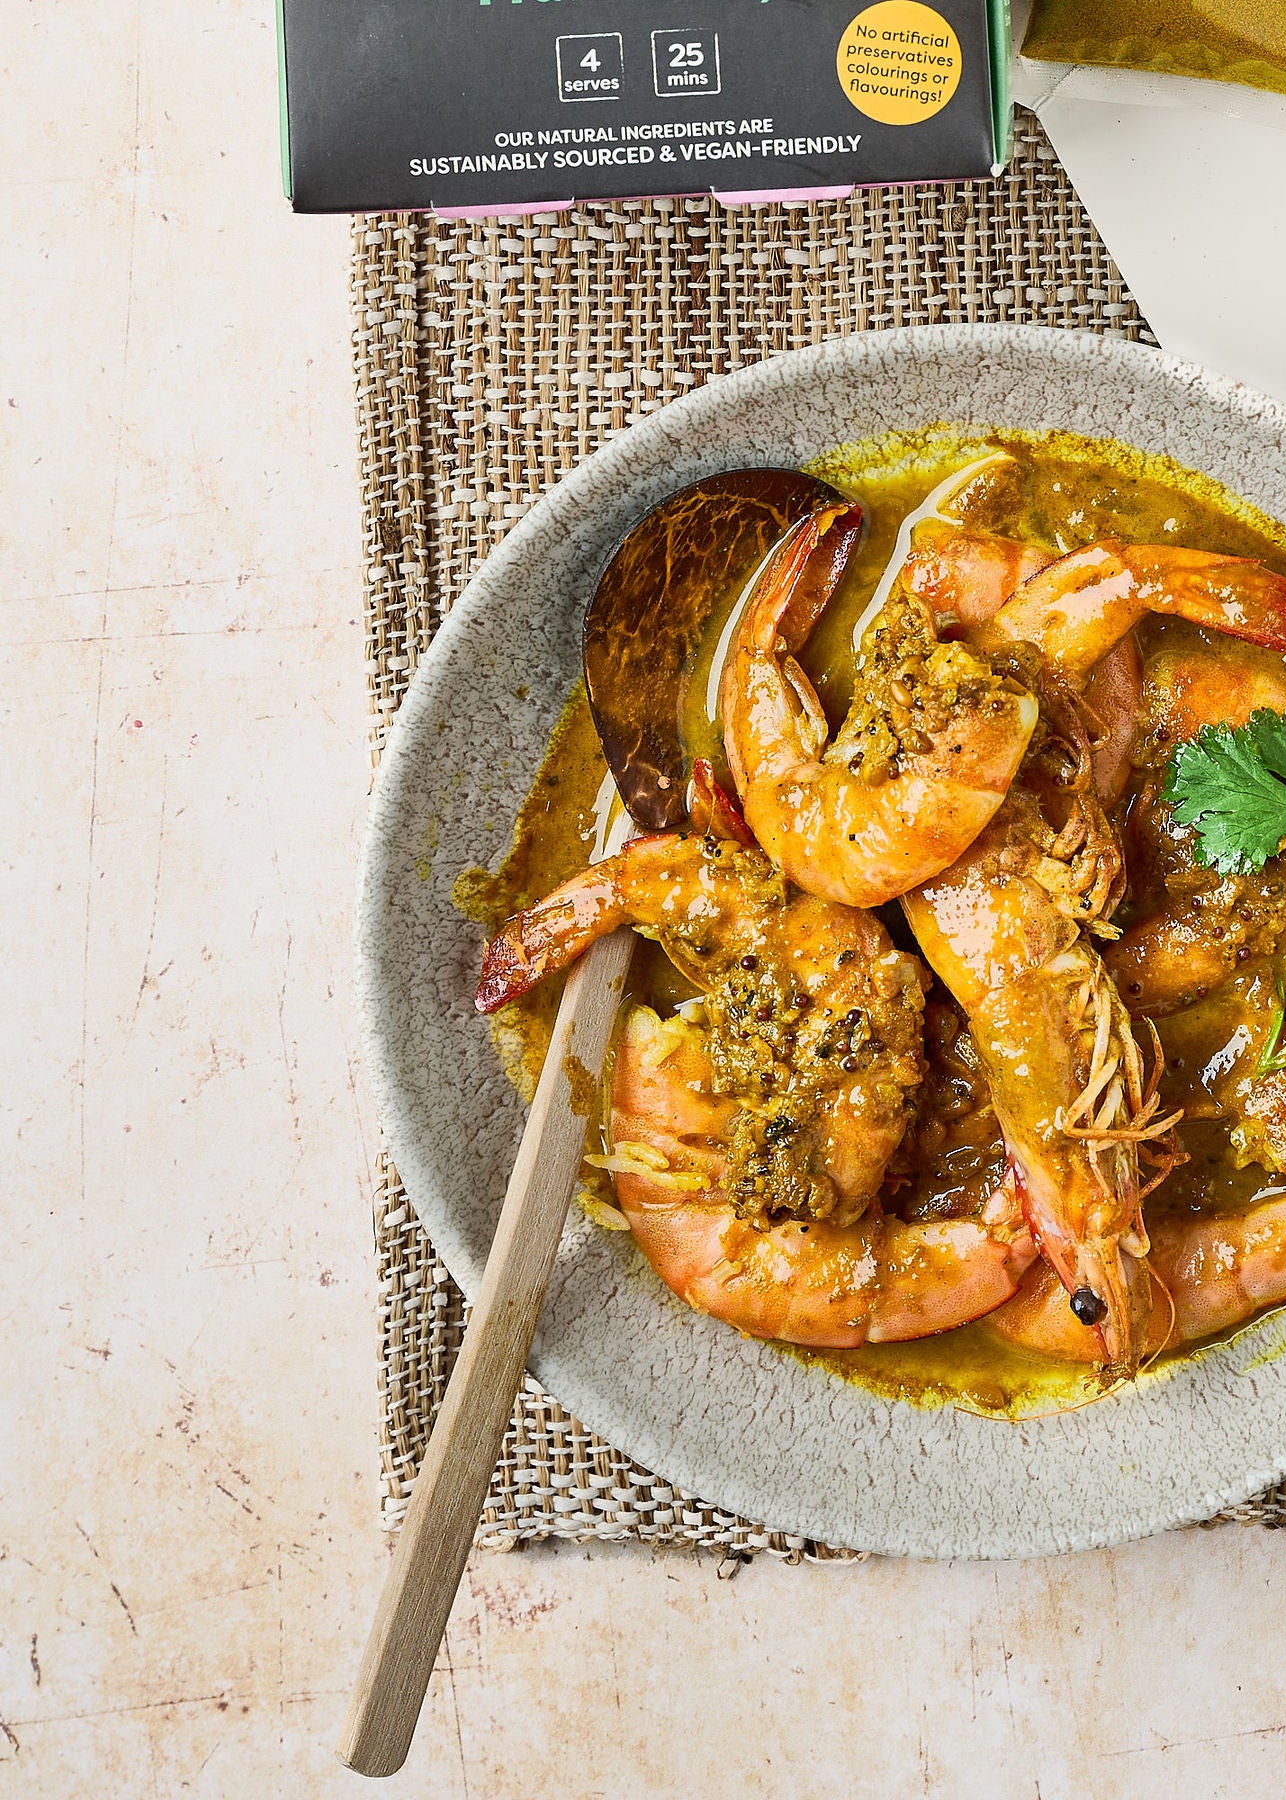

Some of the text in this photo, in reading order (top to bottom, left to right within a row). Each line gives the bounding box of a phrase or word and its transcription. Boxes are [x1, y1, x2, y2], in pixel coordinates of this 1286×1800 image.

[856, 24, 950, 49] No artificial
[579, 48, 602, 72] 4
[668, 42, 705, 68] 25
[846, 44, 953, 69] preservatives
[564, 77, 620, 93] serves
[667, 70, 709, 87] mins
[847, 62, 949, 85] colourings or
[850, 78, 942, 105] flavourings!
[494, 118, 774, 148] OUR NATURAL INGREDIENTS ARE
[409, 134, 862, 176] SUSTAINABLY SOURCED & VEGAN-FRIENDLY
